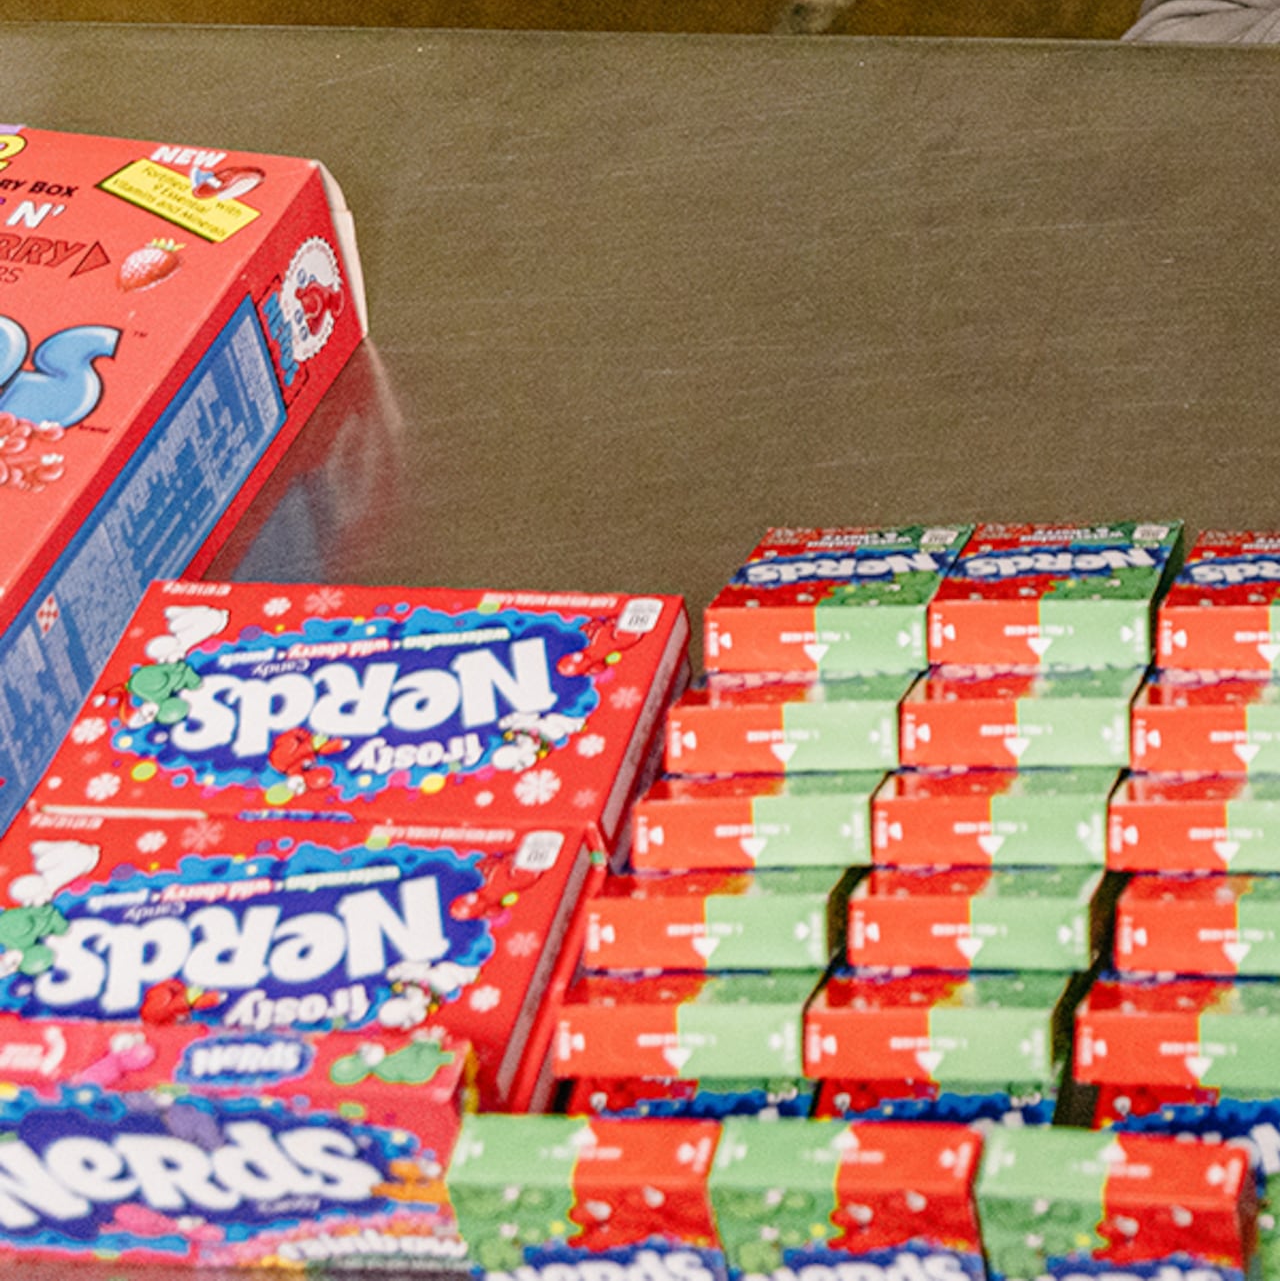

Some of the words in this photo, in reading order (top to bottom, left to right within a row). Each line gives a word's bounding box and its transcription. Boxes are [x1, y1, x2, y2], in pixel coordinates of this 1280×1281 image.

[150, 146, 228, 169] NEW
[28, 179, 79, 198] BOX
[345, 732, 484, 775] frosty
[222, 983, 370, 1032] frosty
